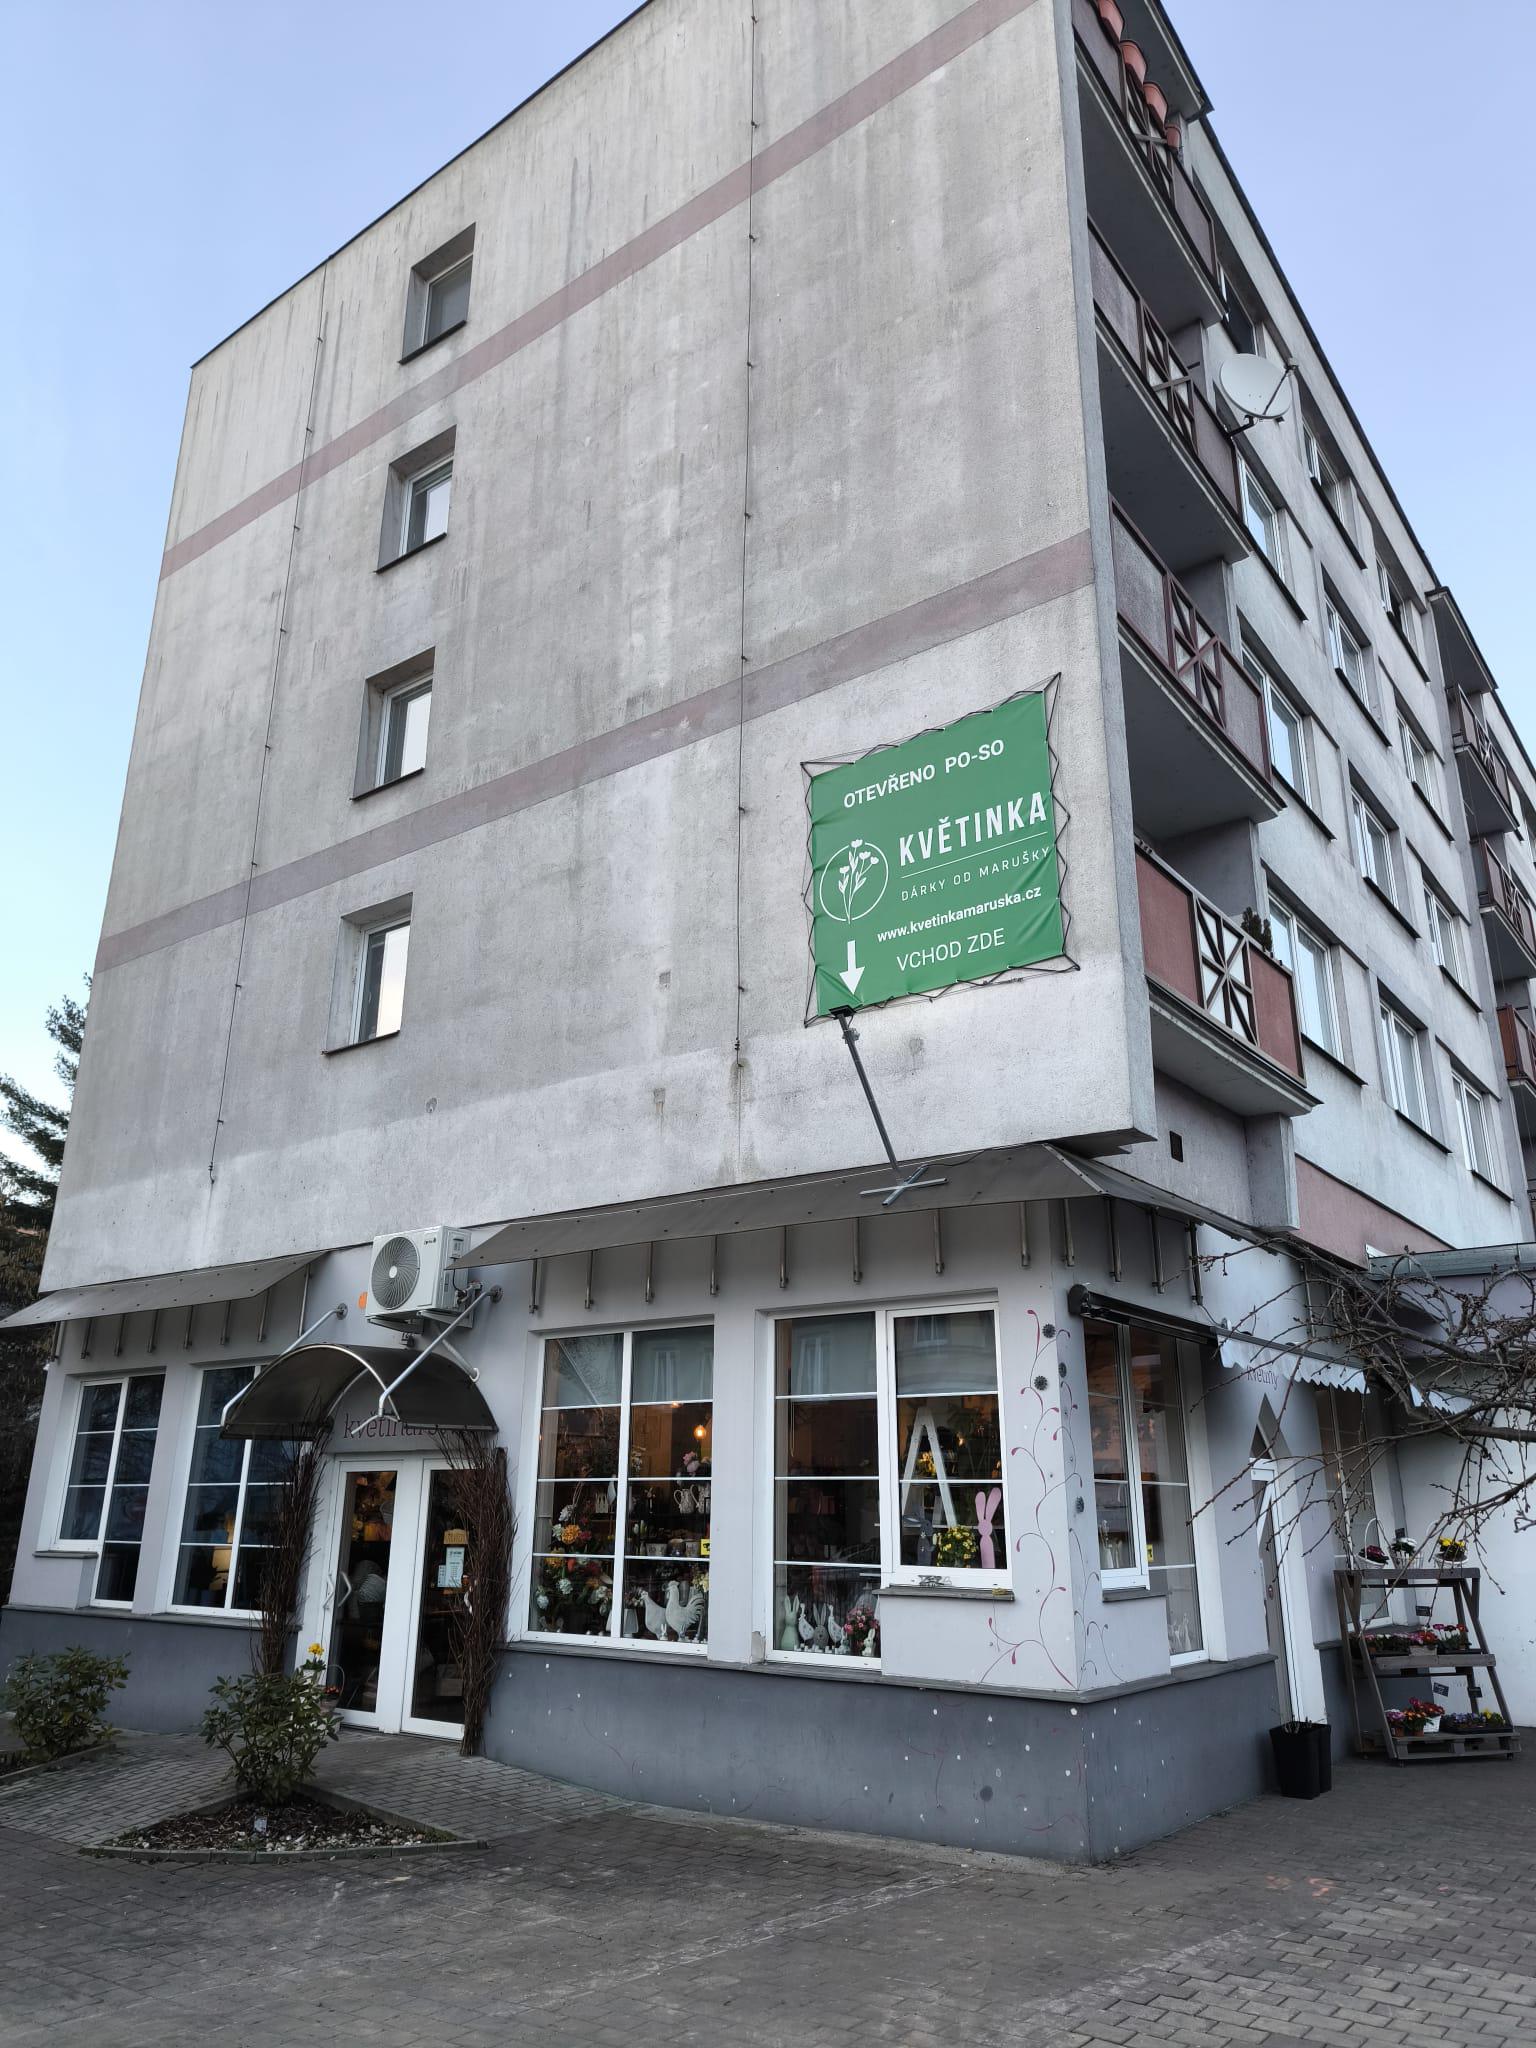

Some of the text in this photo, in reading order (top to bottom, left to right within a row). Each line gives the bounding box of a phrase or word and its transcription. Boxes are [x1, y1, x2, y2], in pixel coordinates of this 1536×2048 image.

[843, 739, 1005, 808] OTEVŘENO PO-SO
[899, 792, 1047, 867] KVĚTINKA
[901, 847, 1050, 902] DÁRKY OD MARUŠKY
[877, 886, 1042, 943] www.kvetinkamaruska.cz
[896, 928, 1005, 972] VCHOD ZDE
